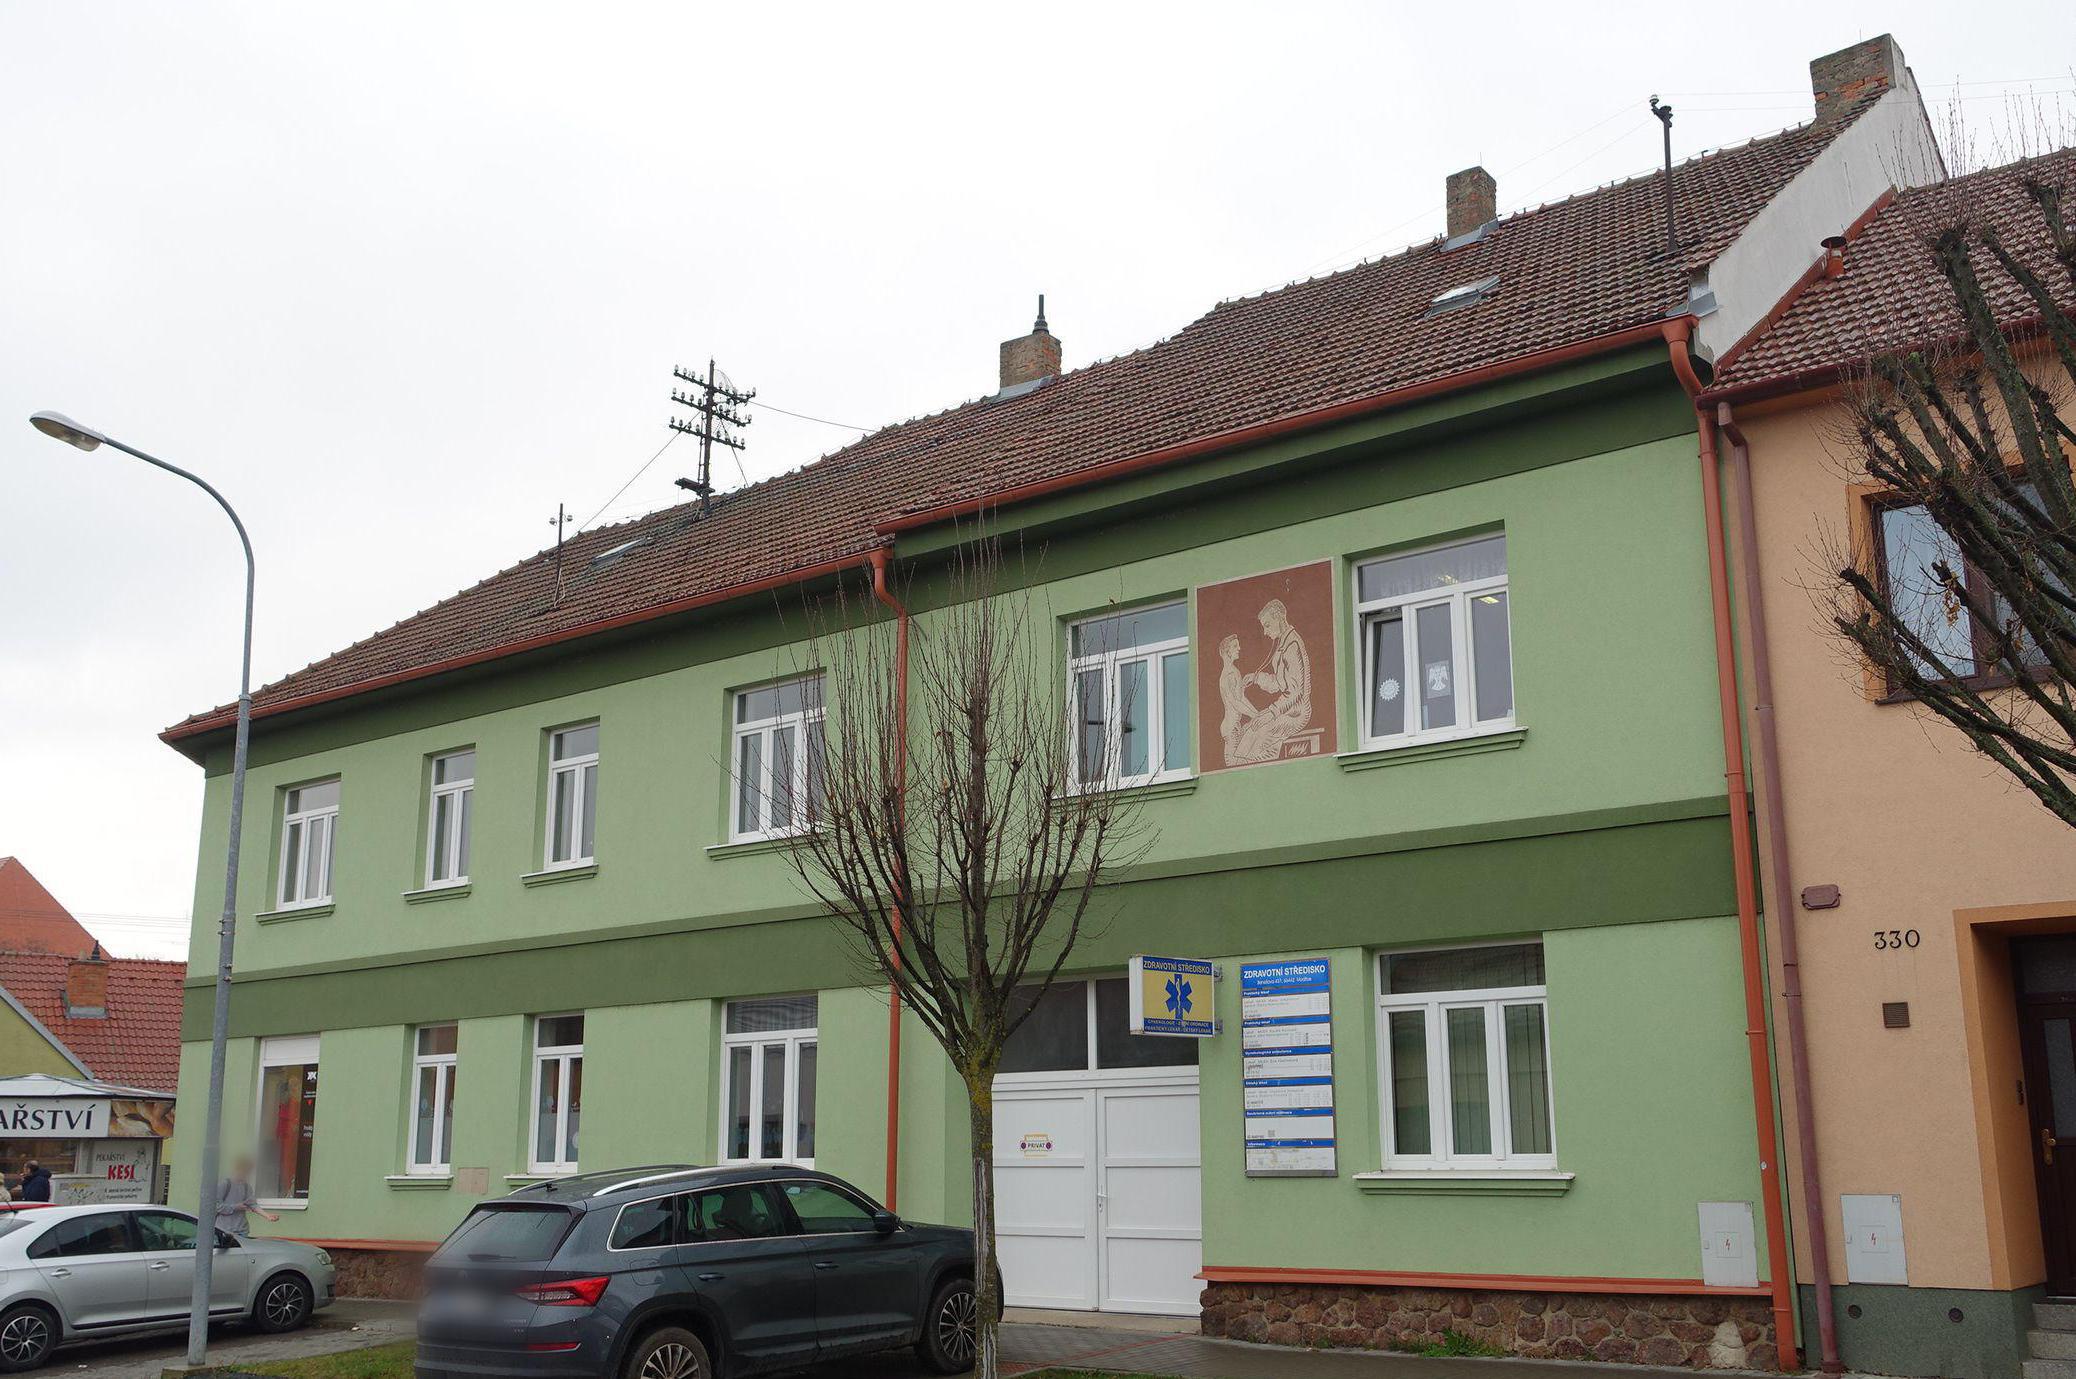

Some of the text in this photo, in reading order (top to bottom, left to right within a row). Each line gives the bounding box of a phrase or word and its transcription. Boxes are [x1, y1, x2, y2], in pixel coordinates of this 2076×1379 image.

[1874, 929, 1920, 949] 330
[1144, 961, 1210, 974] ZDRAVOTNÍ STŘEDISKO
[1244, 965, 1326, 978] ZDRAVOTNÍ STŘEDISKO
